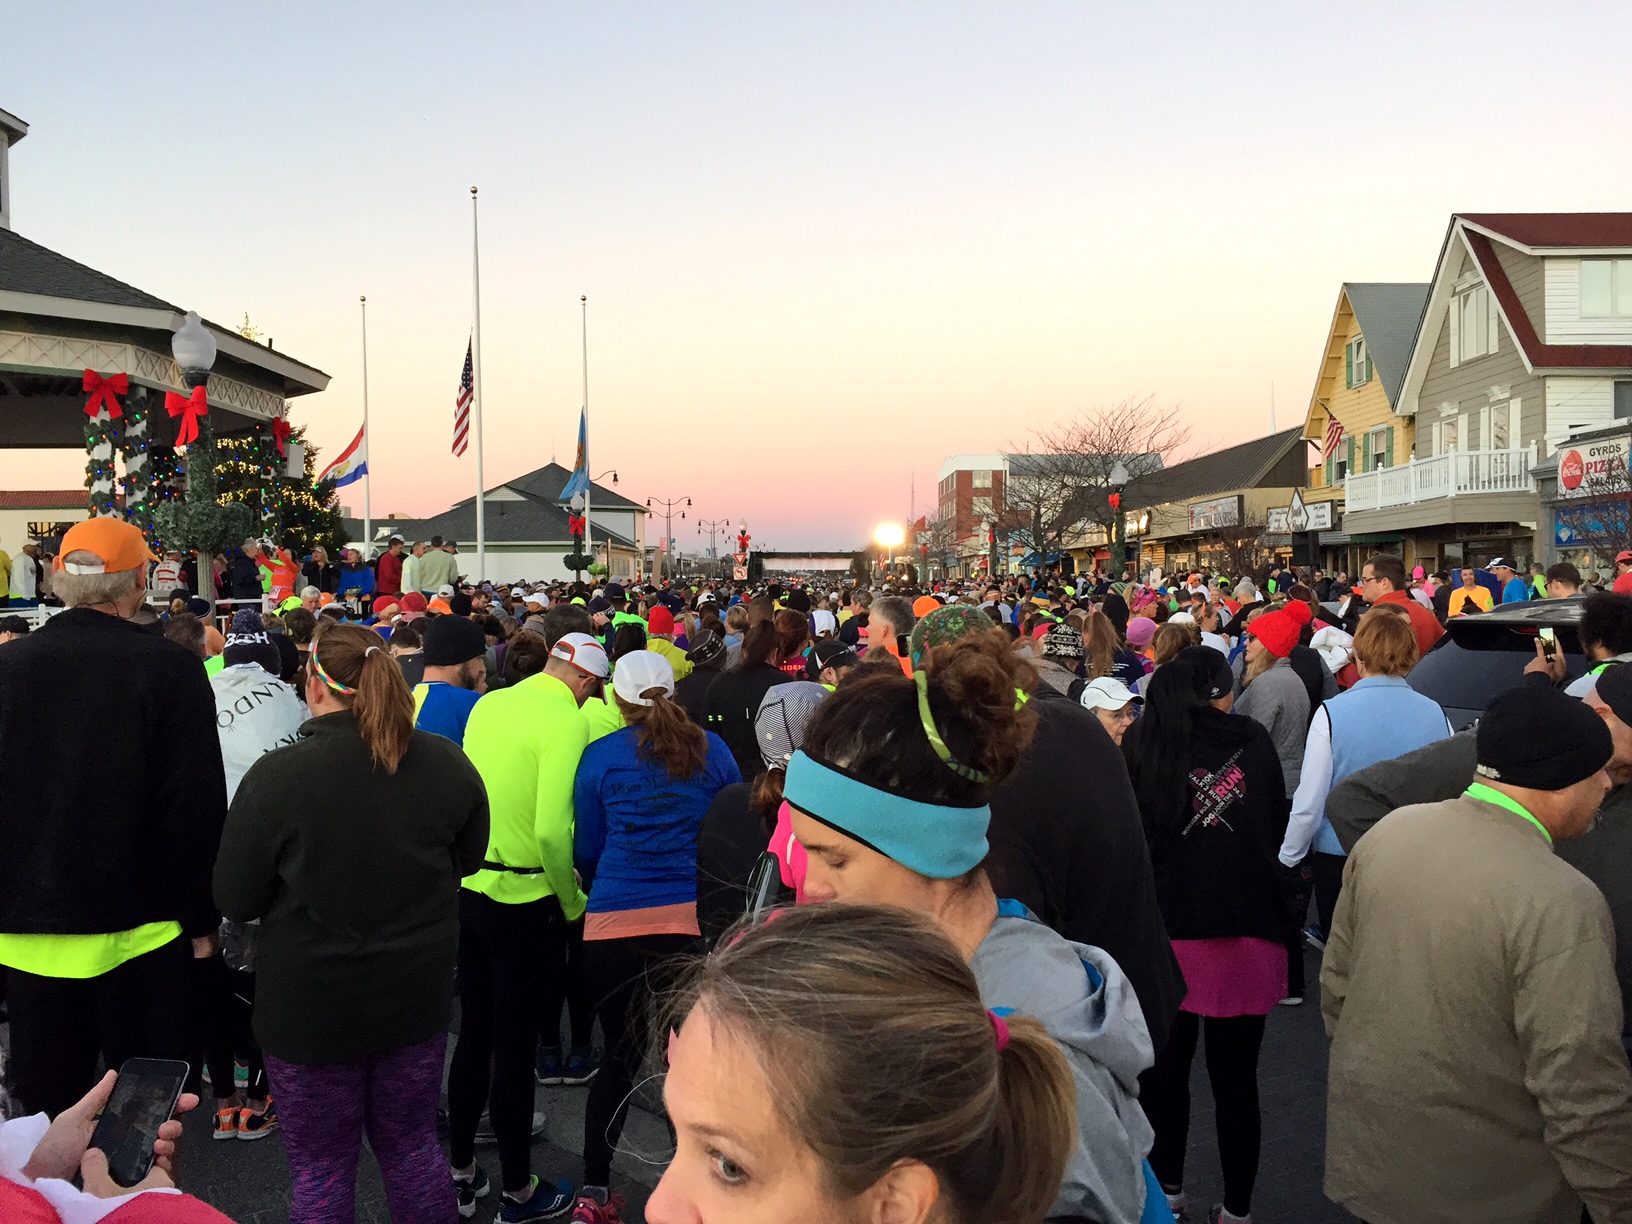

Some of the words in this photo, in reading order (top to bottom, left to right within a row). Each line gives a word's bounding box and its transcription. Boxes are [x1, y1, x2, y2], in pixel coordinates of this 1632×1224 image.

[1589, 444, 1621, 457] GYROS
[1585, 455, 1627, 475] PIZZA
[1201, 772, 1214, 784] 10K
[1214, 766, 1245, 798] RUN!
[1208, 789, 1222, 802] RUN
[1214, 800, 1225, 812] JOIN
[1223, 792, 1233, 802] THE
[1202, 813, 1216, 828] JOG
[1210, 817, 1220, 826] 5K
